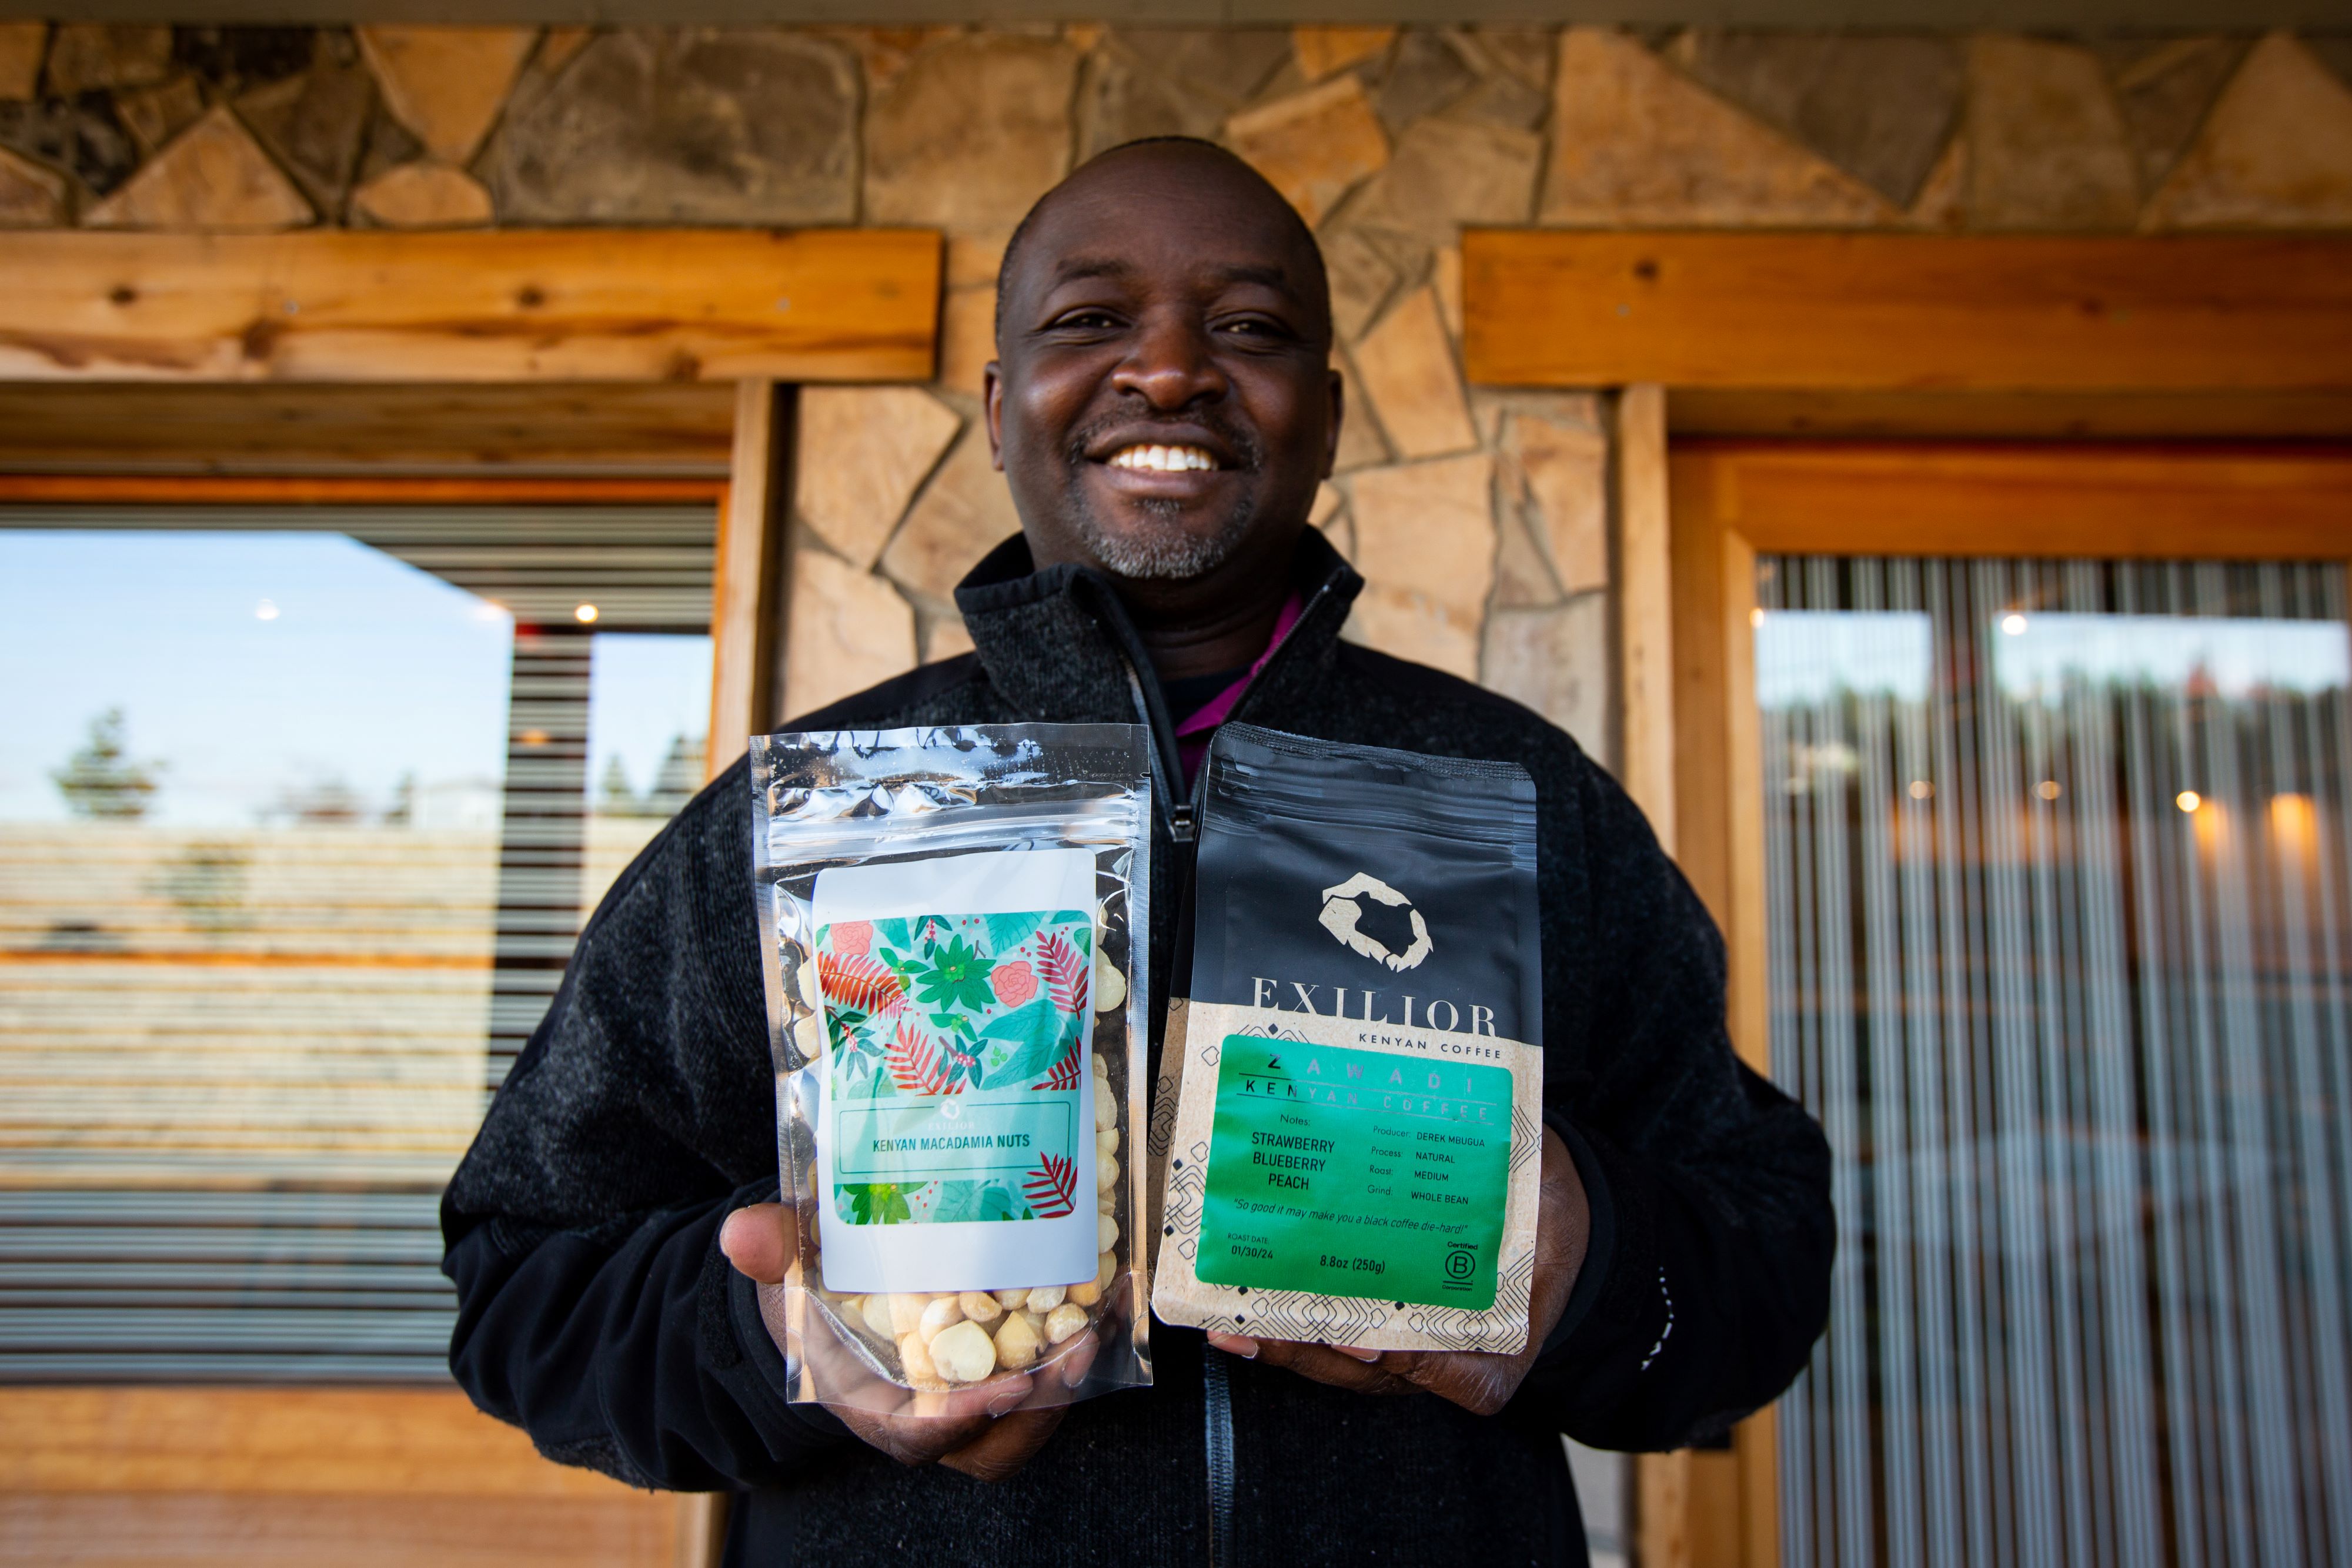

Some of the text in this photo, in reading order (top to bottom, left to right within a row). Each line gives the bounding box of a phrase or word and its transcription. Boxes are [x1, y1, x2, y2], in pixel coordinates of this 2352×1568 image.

[1251, 977, 1500, 1038] EXILIOR
[1359, 1034, 1501, 1059] KENYAN COFFEE
[1268, 1053, 1472, 1092] ZAWADI
[1246, 1079, 1487, 1120] KENYAN COFFEE
[928, 1121, 975, 1131] EXILIOR
[1280, 1114, 1310, 1126] Notes:
[873, 1134, 1030, 1152] KENYAN MACADAMIA NUTS
[1252, 1132, 1335, 1153] STRAWBERRY
[1373, 1125, 1485, 1147] Producer: DEREK MBUGUA
[1253, 1152, 1326, 1172] BLUEBERRY
[1371, 1146, 1455, 1164] Process: NATURAL
[1268, 1173, 1309, 1191] PEACH
[1369, 1165, 1449, 1181] Roast: MEDIUM
[1367, 1185, 1469, 1205] Grind: WHOLE BEAN
[1234, 1198, 1249, 1210] "So
[1251, 1203, 1276, 1213] good
[1277, 1204, 1284, 1215] it
[1285, 1207, 1307, 1220] may
[1308, 1211, 1335, 1221] make
[1337, 1214, 1354, 1223] you
[1364, 1215, 1389, 1226] black
[1391, 1219, 1419, 1230] coffee
[1421, 1221, 1468, 1235] die-hard!"
[1228, 1232, 1250, 1242] ROAST
[1447, 1241, 1478, 1250] Certified
[1231, 1245, 1274, 1259] 01/30/24
[1319, 1255, 1385, 1275] 8.8oz (250g)
[1452, 1256, 1468, 1273] B
